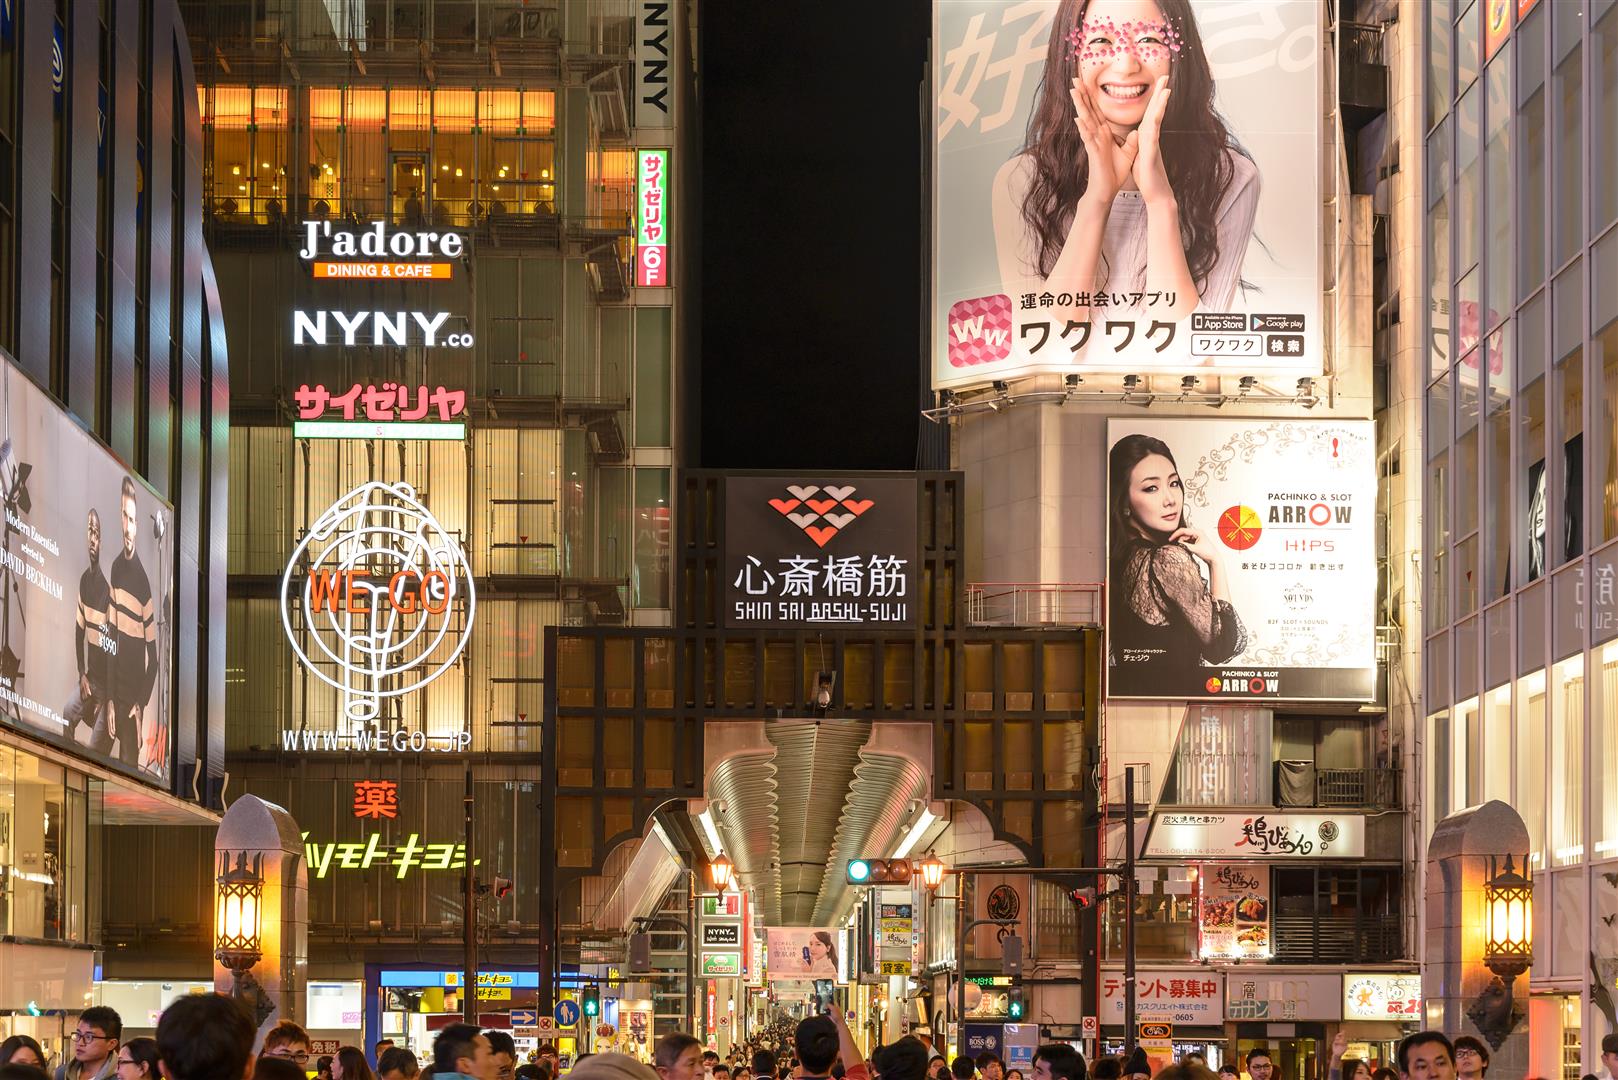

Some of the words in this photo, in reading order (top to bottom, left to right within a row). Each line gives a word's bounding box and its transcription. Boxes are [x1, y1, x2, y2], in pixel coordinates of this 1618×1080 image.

[643, 3, 668, 114] NYNY
[644, 156, 661, 240] サイゼリヤ
[300, 220, 463, 259] J'adore
[327, 265, 377, 277] DINING
[381, 265, 391, 277] &
[394, 265, 432, 277] CAFE
[643, 246, 661, 285] 6F
[1020, 291, 1177, 310] 運命の出会いアプリ
[293, 310, 474, 347] NYNY.co
[1204, 320, 1221, 330] App
[1222, 320, 1243, 329] Store
[1266, 320, 1289, 329] Google
[1290, 320, 1304, 329] play
[1020, 320, 1177, 355] ワクワク
[1199, 339, 1254, 351] ワクワク
[1271, 339, 1300, 353] 検索
[295, 382, 465, 421] サイゼリヤ
[1268, 493, 1317, 501] PACHINKO
[1268, 503, 1353, 527] ARROW
[0, 546, 25, 576] DAVID
[25, 563, 63, 600] BECKHAM
[733, 554, 908, 598] 心斎橋筋
[735, 602, 772, 620] SHIN
[778, 602, 804, 620] SAI
[1222, 677, 1279, 694] ARROW
[282, 729, 472, 752] WWW.WEGO.JP
[353, 780, 398, 819] 薬
[301, 831, 481, 879] ツモトキヨシ
[312, 1041, 337, 1054] 免税
[969, 1038, 985, 1046] BOSS
